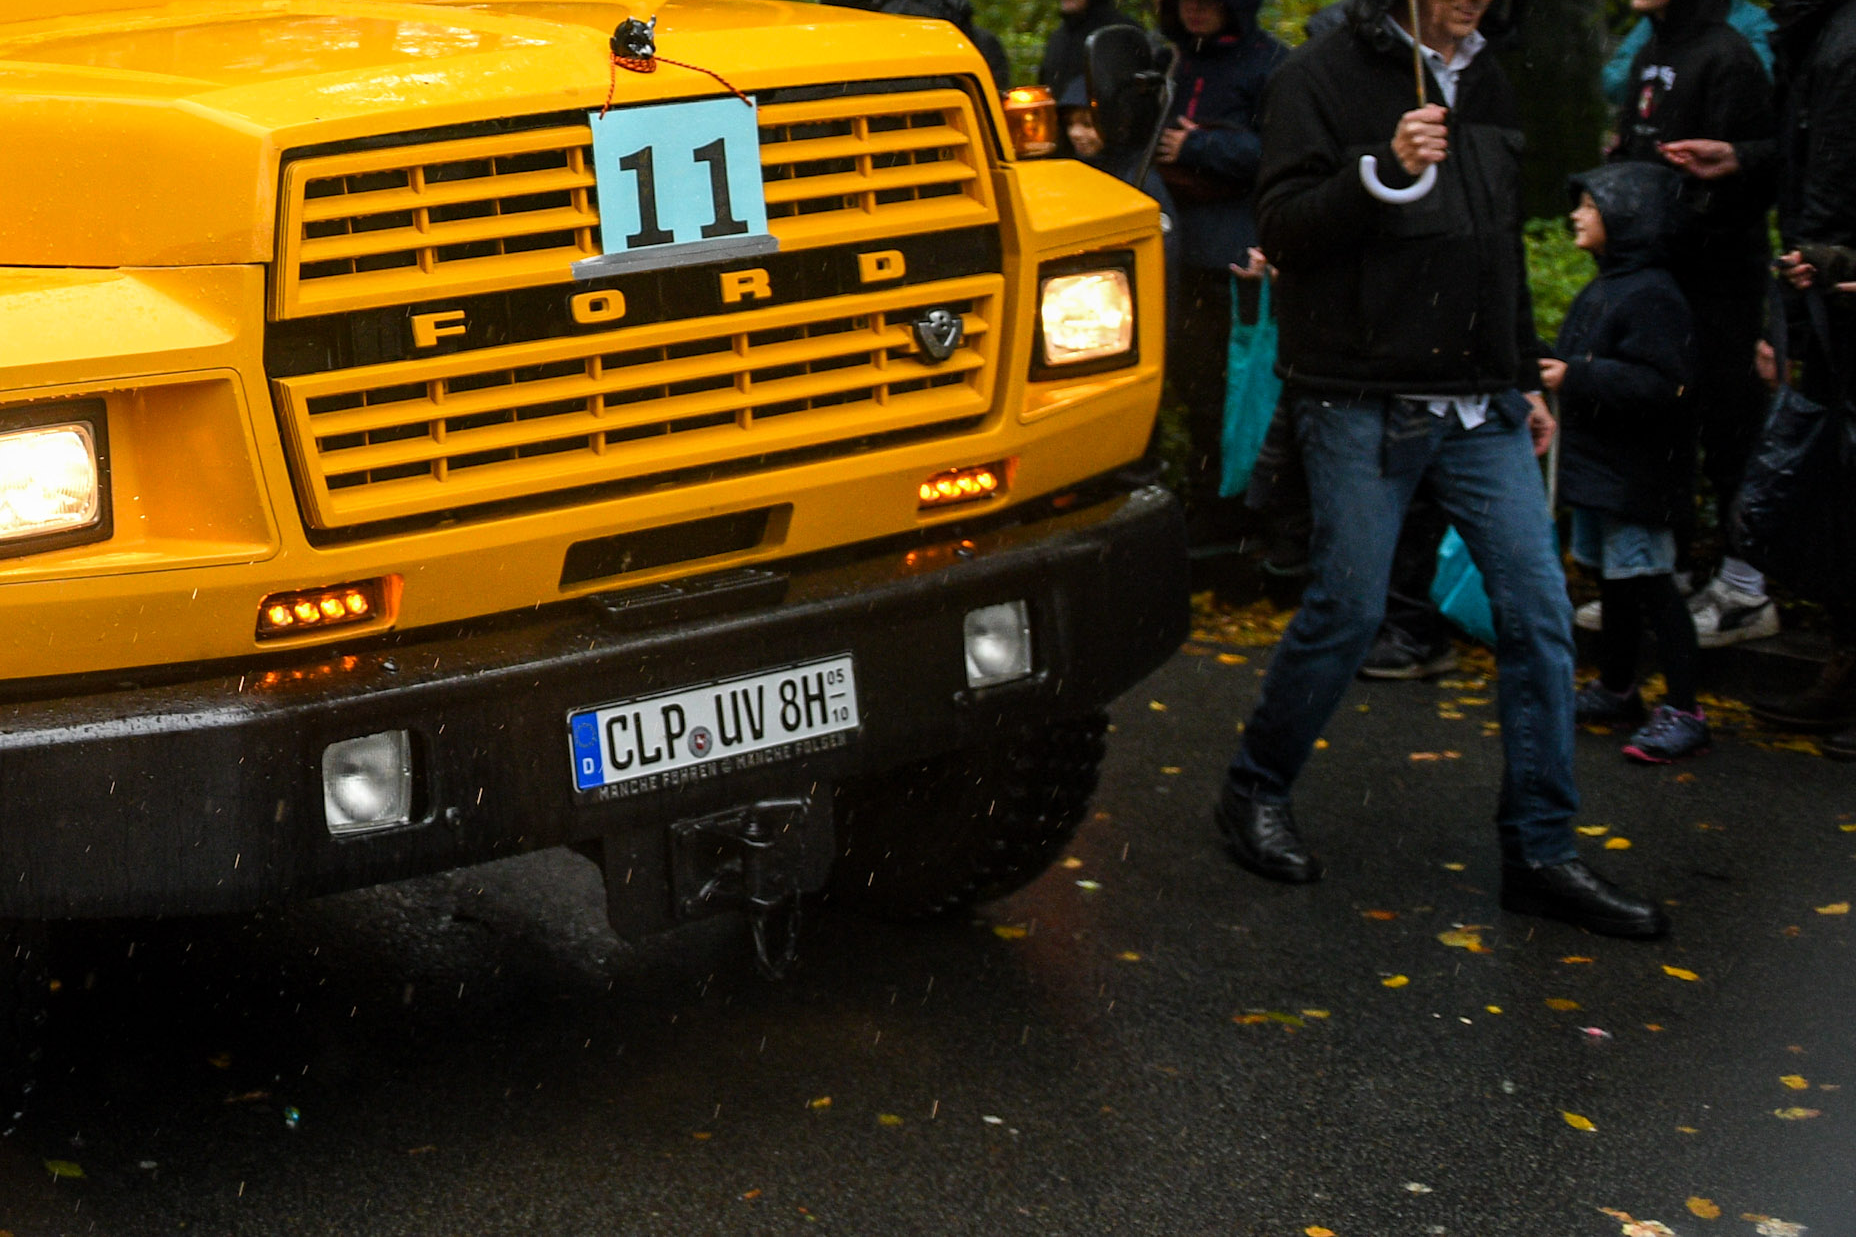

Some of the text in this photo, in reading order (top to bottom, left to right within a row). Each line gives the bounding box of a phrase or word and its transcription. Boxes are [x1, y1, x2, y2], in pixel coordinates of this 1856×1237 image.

[618, 137, 749, 249] 11
[411, 249, 906, 348] FORD
[827, 668, 844, 685] 05
[606, 672, 828, 771] CLP UV 8H
[832, 706, 849, 723] 10
[582, 757, 594, 775] D
[599, 775, 658, 800] MANCHE
[736, 745, 792, 770] MANCHE
[795, 731, 846, 755] FOLGEN
